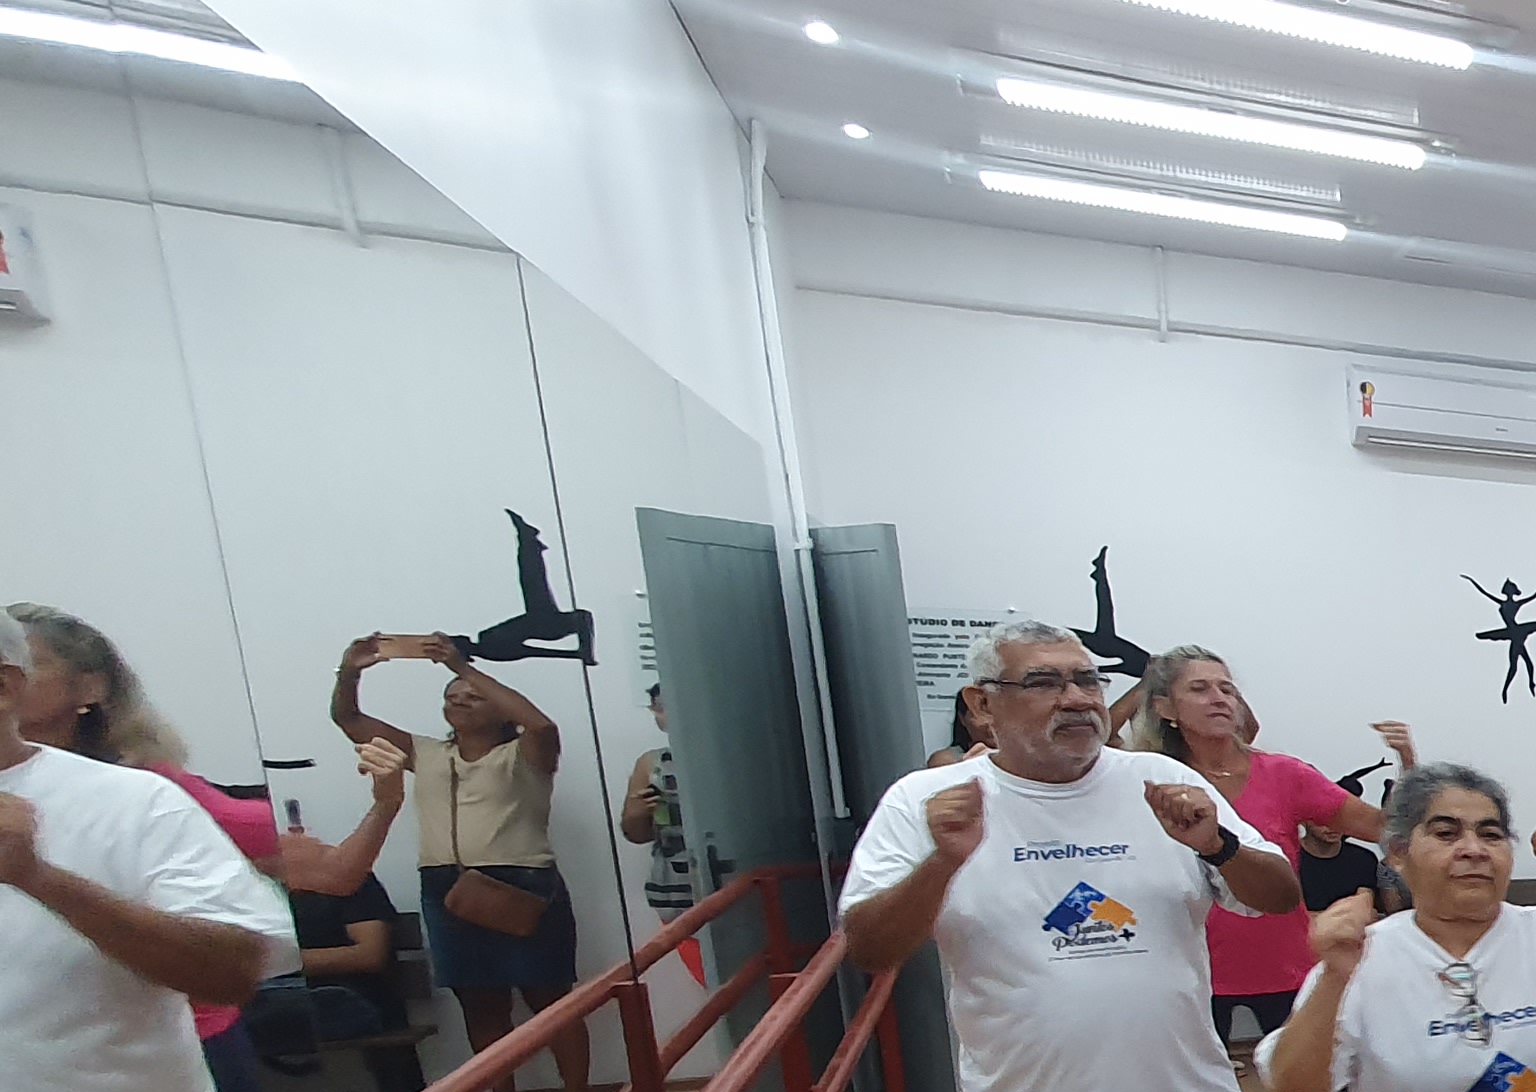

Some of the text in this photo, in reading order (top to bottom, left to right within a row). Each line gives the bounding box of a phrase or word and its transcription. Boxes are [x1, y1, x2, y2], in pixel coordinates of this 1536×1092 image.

[952, 618, 966, 627] DE
[970, 619, 999, 628] DAN
[1014, 843, 1130, 862] Envelhecer
